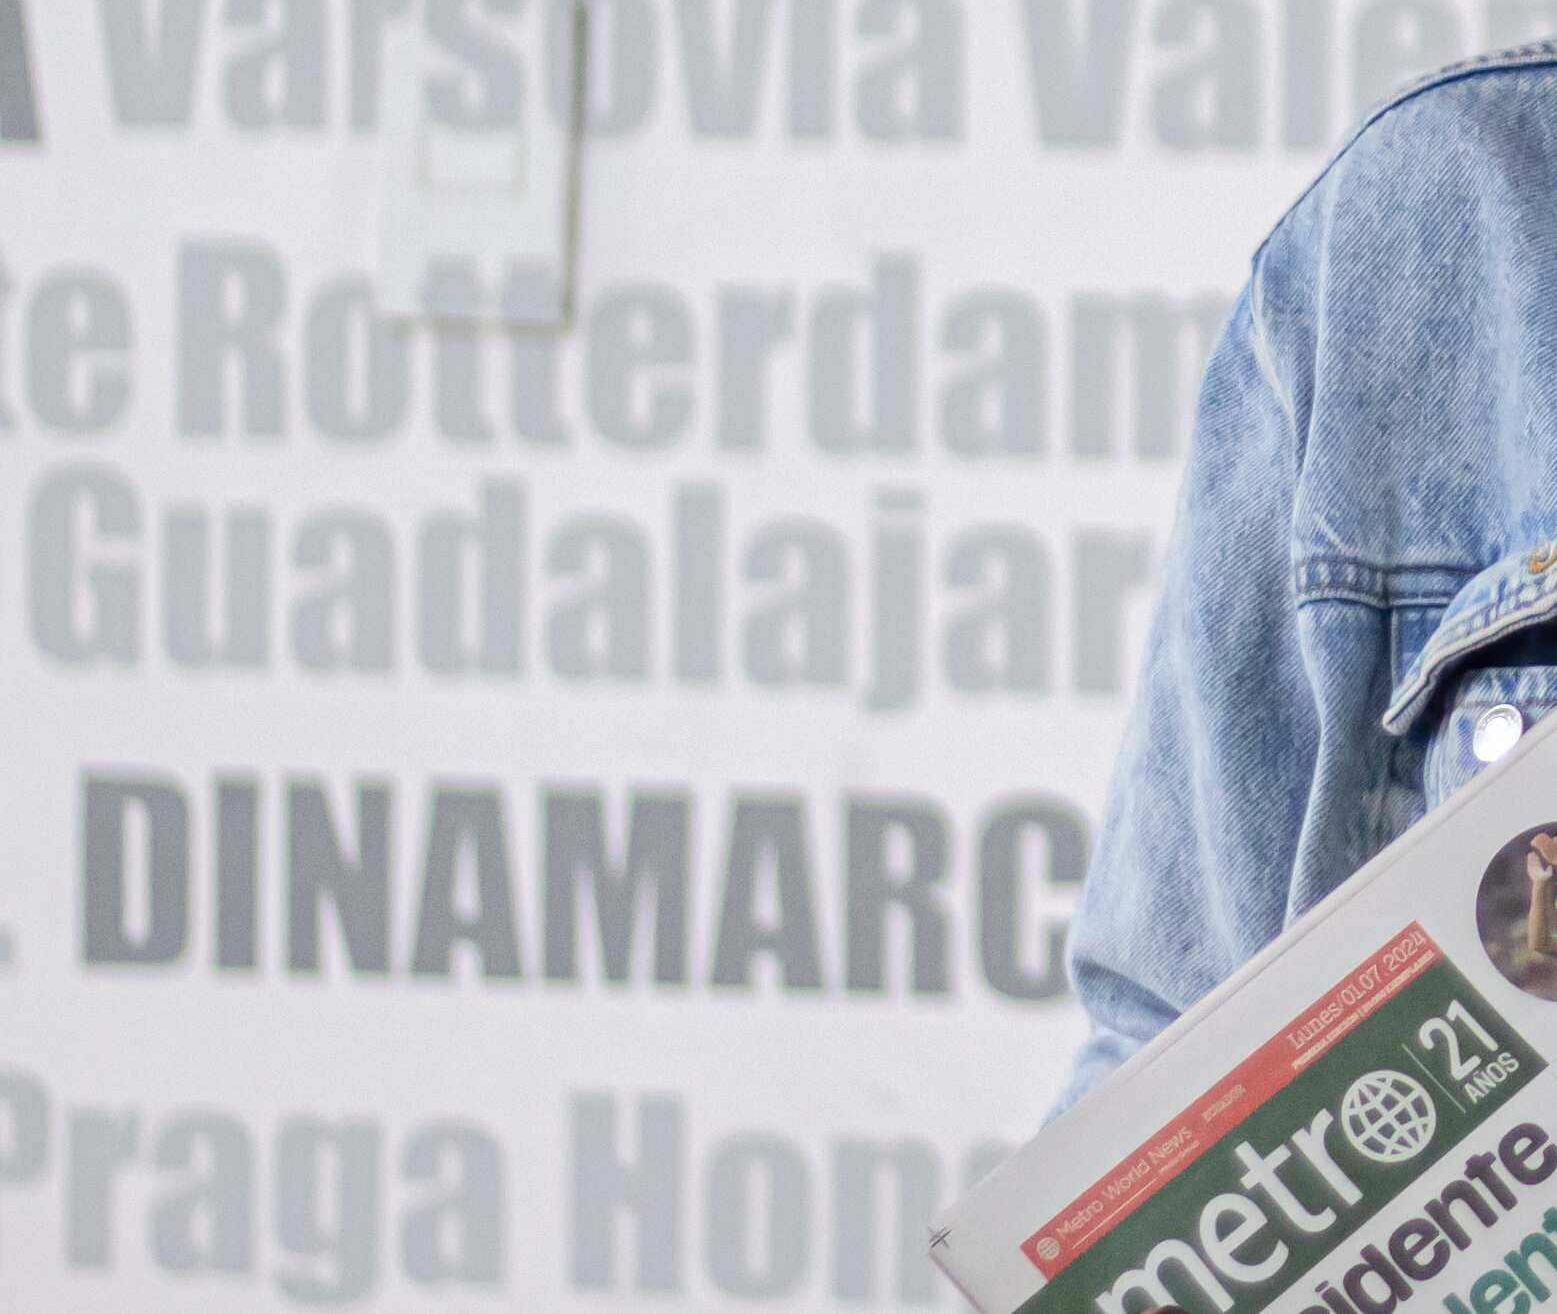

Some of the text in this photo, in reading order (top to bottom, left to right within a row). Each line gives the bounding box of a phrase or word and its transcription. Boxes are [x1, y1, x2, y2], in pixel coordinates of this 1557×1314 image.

[177, 234, 1237, 461] Rotterdam
[80, 768, 1093, 1003] DINAMARC
[1419, 1000, 1499, 1081] 21
[1463, 1052, 1521, 1105] AÑOS
[567, 1089, 1015, 1310] Hon
[1055, 1199, 1104, 1239] Metro
[1101, 1158, 1151, 1200] World
[1147, 1126, 1192, 1165] News
